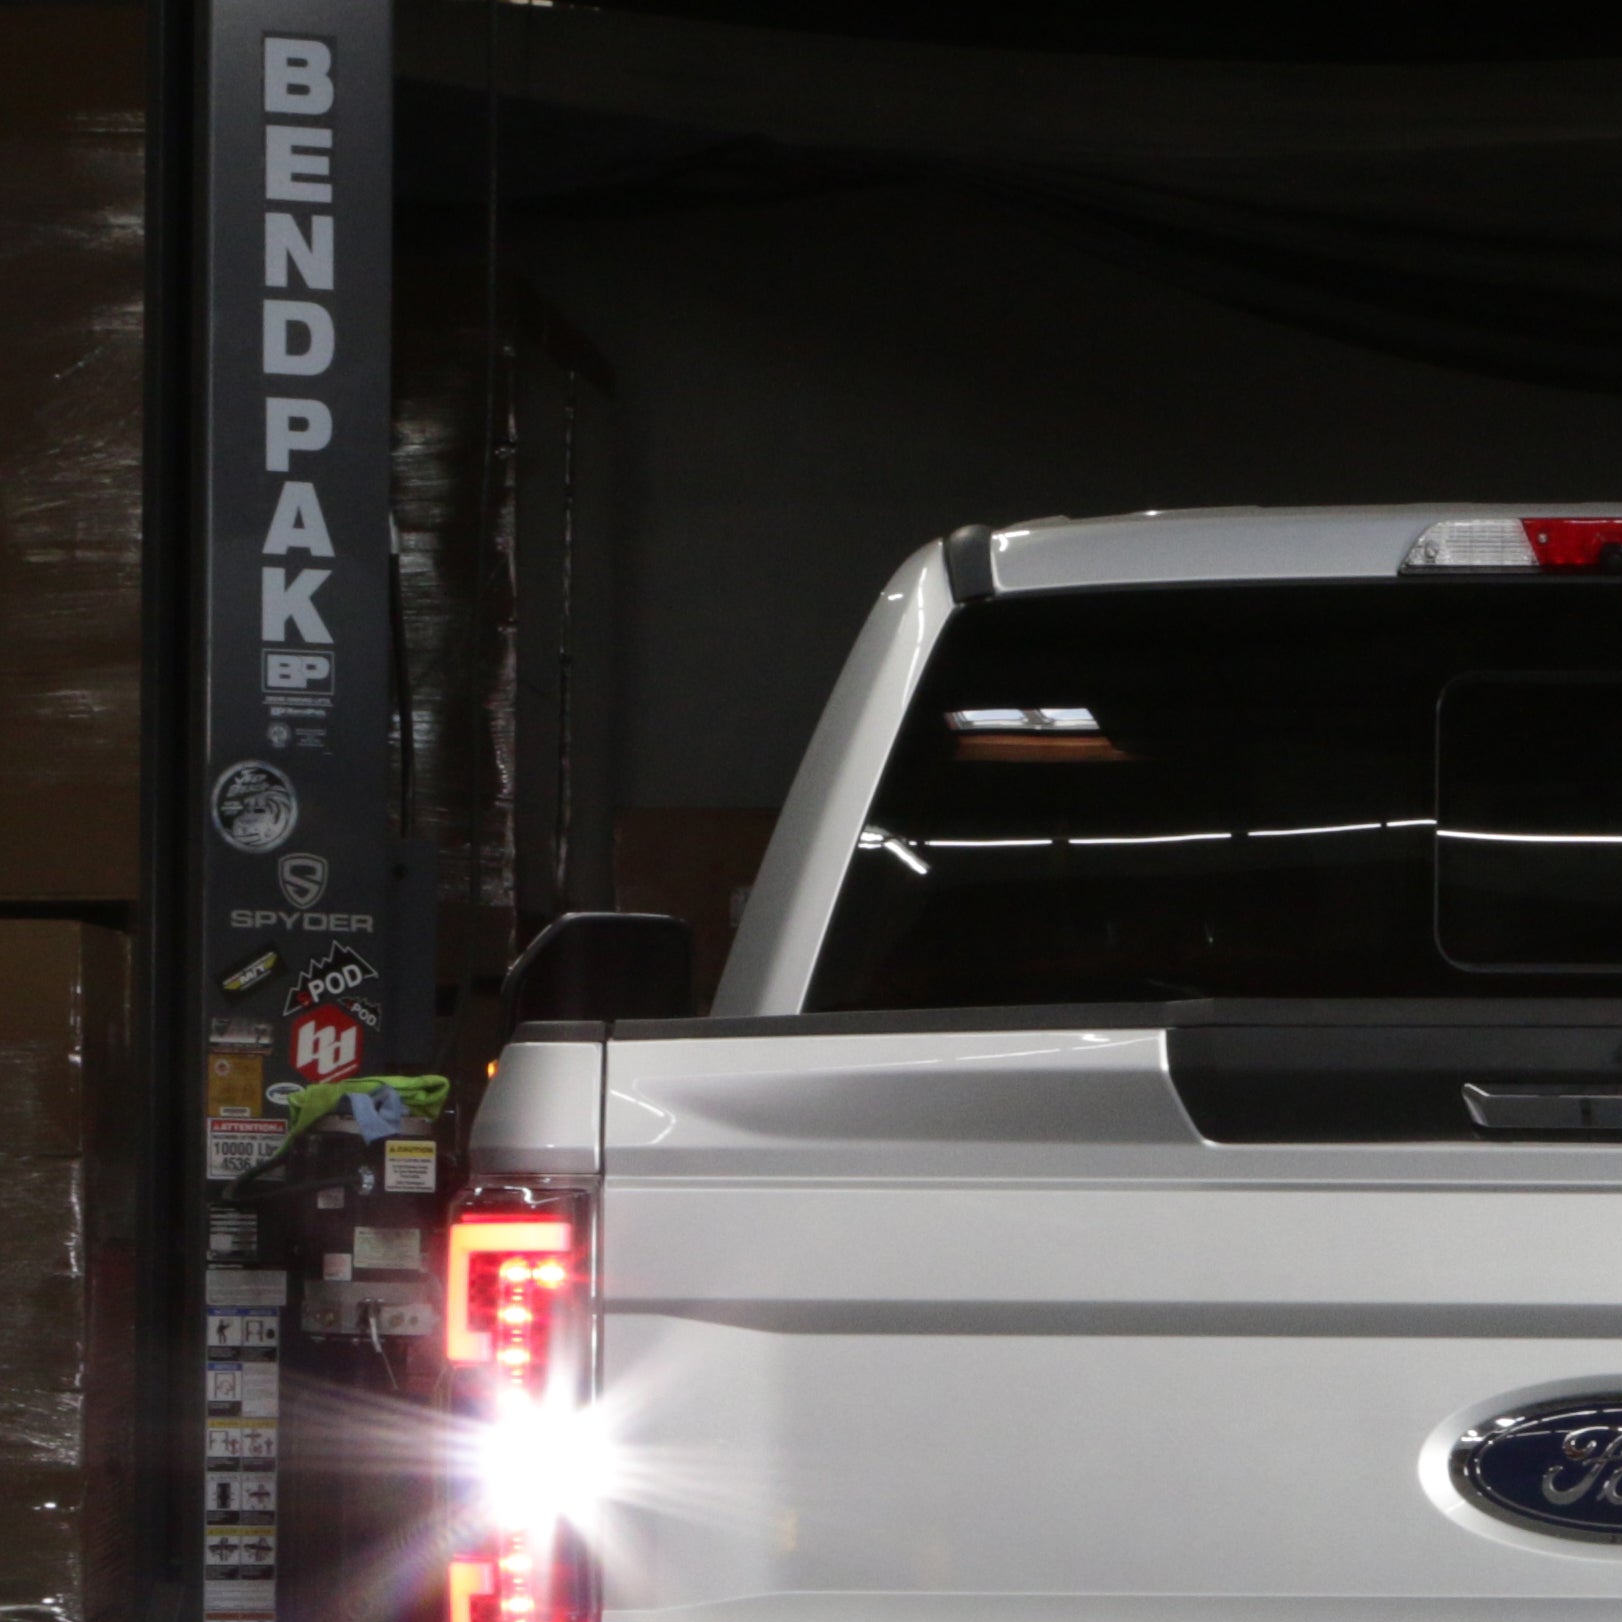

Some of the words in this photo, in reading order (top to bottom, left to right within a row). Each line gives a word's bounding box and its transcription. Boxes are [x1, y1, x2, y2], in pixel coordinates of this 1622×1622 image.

[262, 36, 336, 645] BENDPAK
[266, 653, 331, 689] BP
[230, 909, 375, 933] SPYDER
[219, 1122, 278, 1133] ATTENTION
[214, 1141, 254, 1157] 10000
